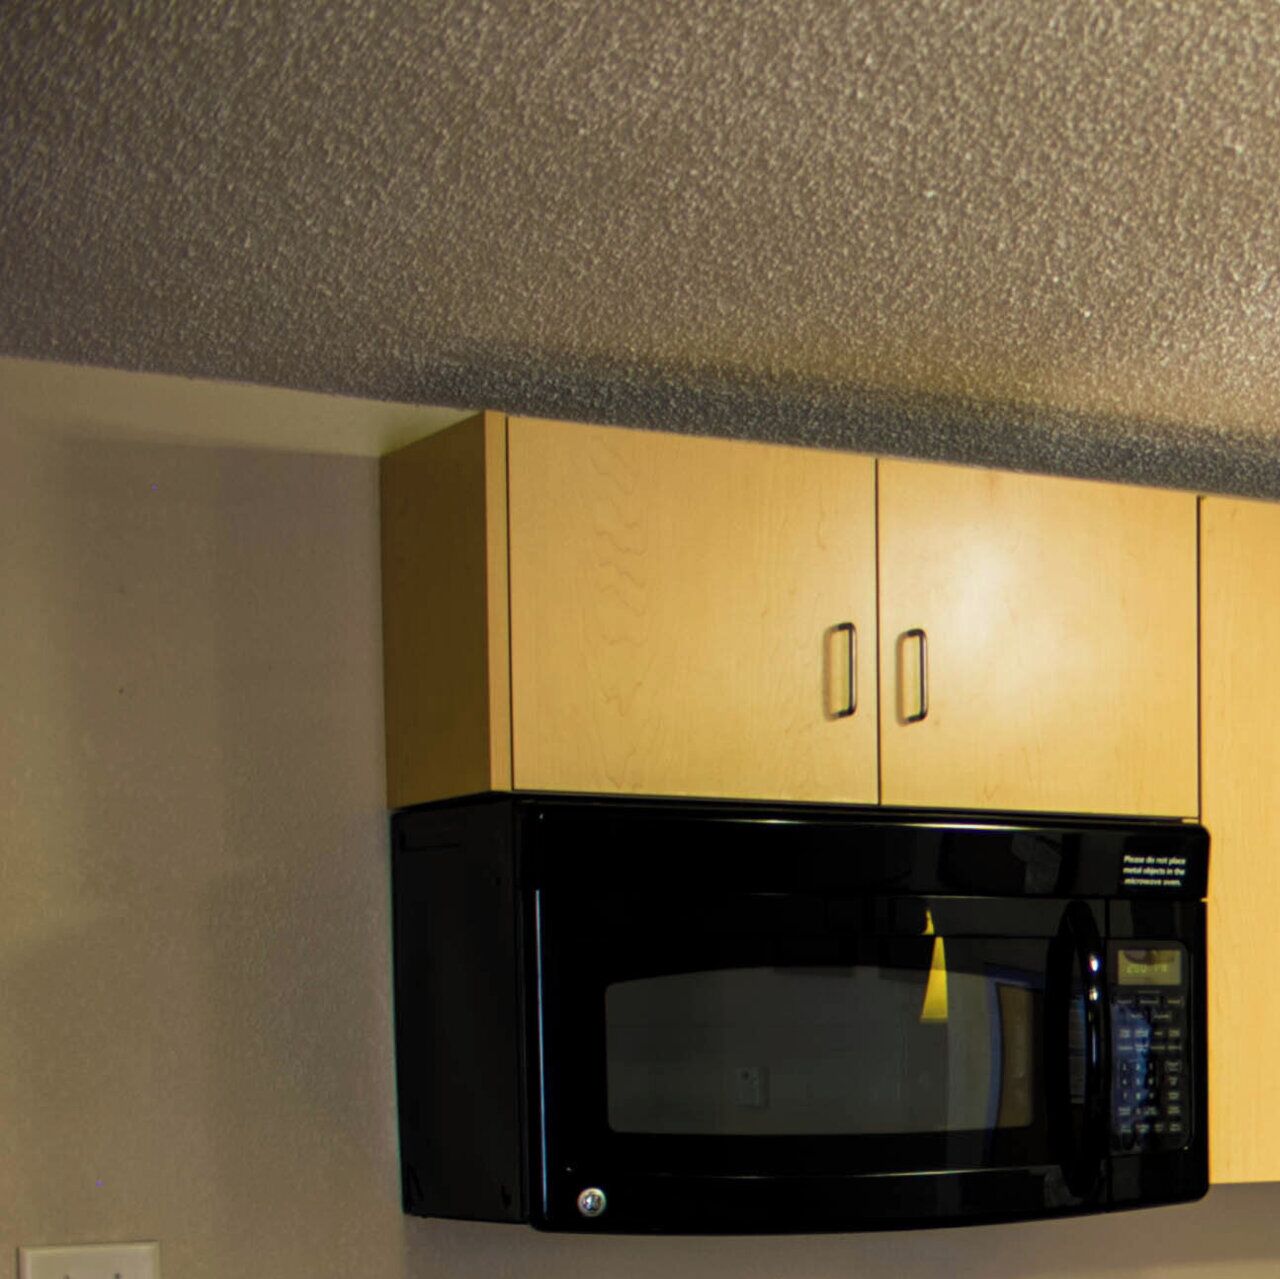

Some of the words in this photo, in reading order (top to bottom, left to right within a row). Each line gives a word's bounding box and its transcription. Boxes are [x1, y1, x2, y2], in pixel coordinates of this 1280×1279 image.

[1124, 855, 1145, 865] Please
[1145, 856, 1155, 865] do
[1156, 856, 1168, 865] not
[1168, 857, 1186, 866] place
[1122, 867, 1143, 875] metal
[1143, 867, 1166, 876] objects
[1166, 868, 1174, 876] in
[1174, 868, 1186, 876] the
[1123, 877, 1162, 886] microwave
